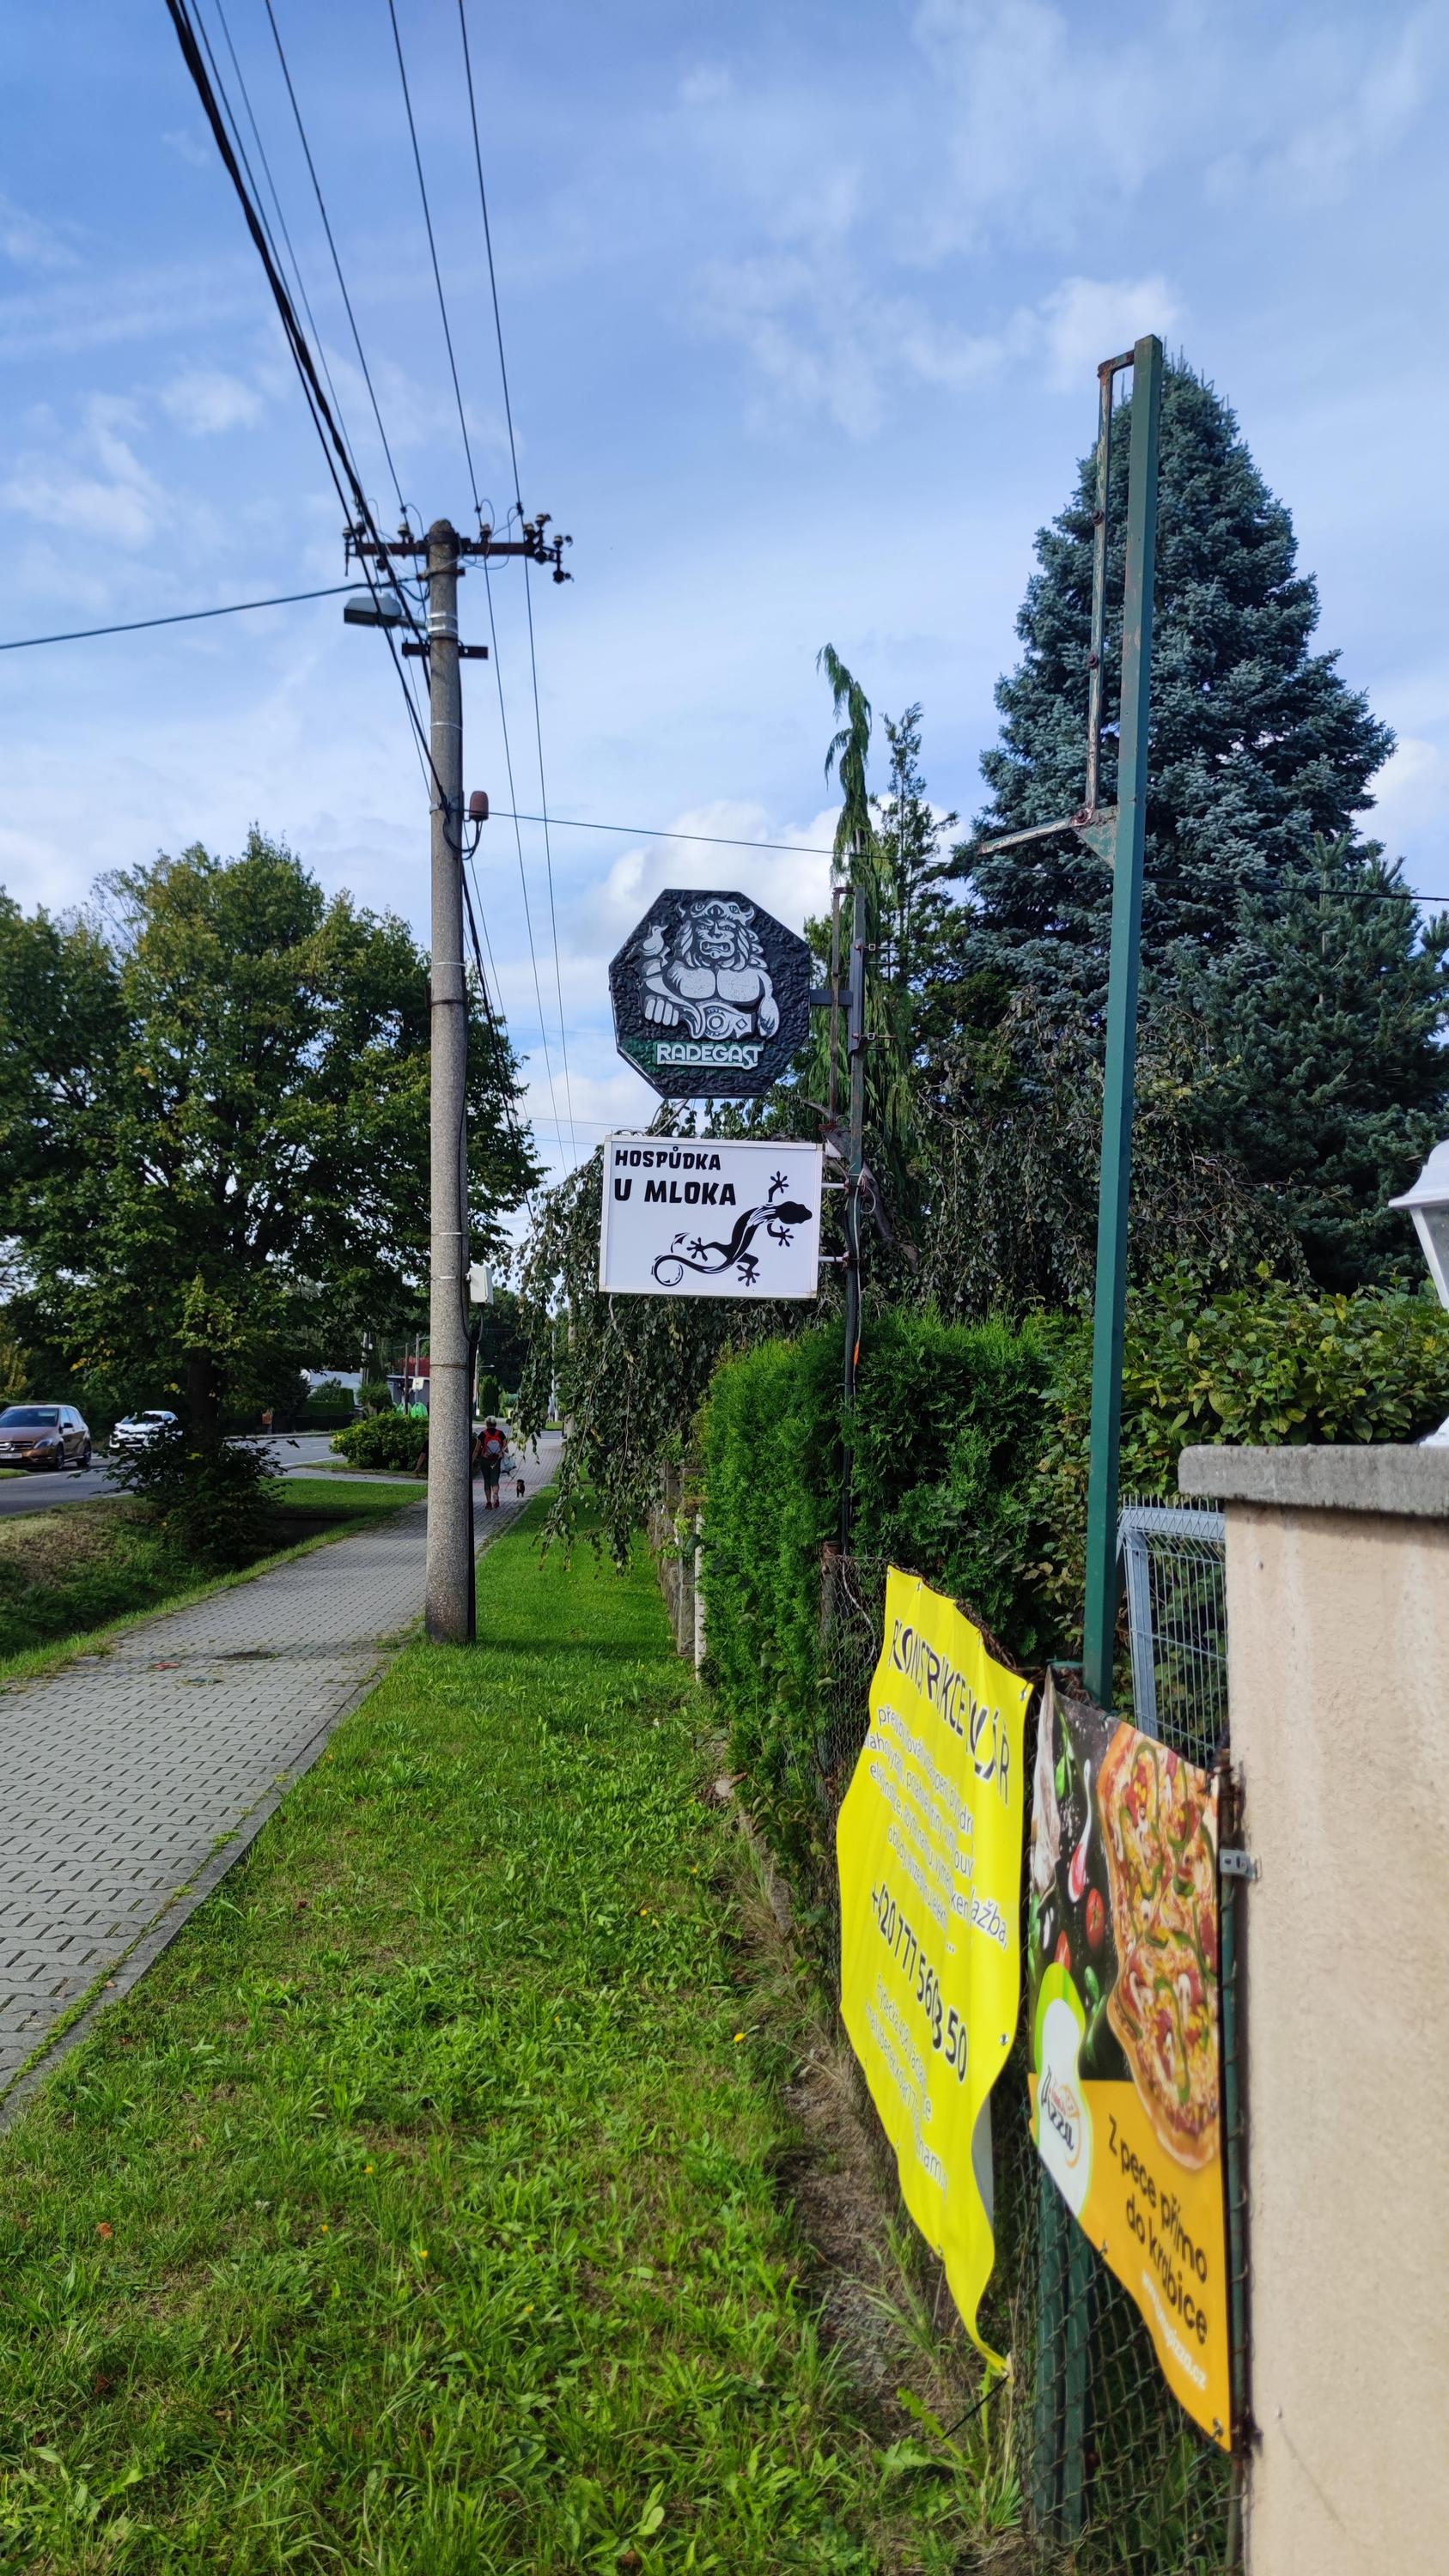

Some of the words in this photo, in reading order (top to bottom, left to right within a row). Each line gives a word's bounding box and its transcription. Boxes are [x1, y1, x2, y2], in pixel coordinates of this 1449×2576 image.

[657, 1042, 764, 1070] RADEGAST
[614, 1145, 721, 1171] HOSPŮDKA
[614, 1177, 633, 1201] U
[644, 1179, 737, 1206] MLOKA
[1119, 2137, 1157, 2208] pece
[1160, 2190, 1208, 2285] přímo
[1126, 2192, 1146, 2245] do
[1148, 2215, 1208, 2346] krabice
